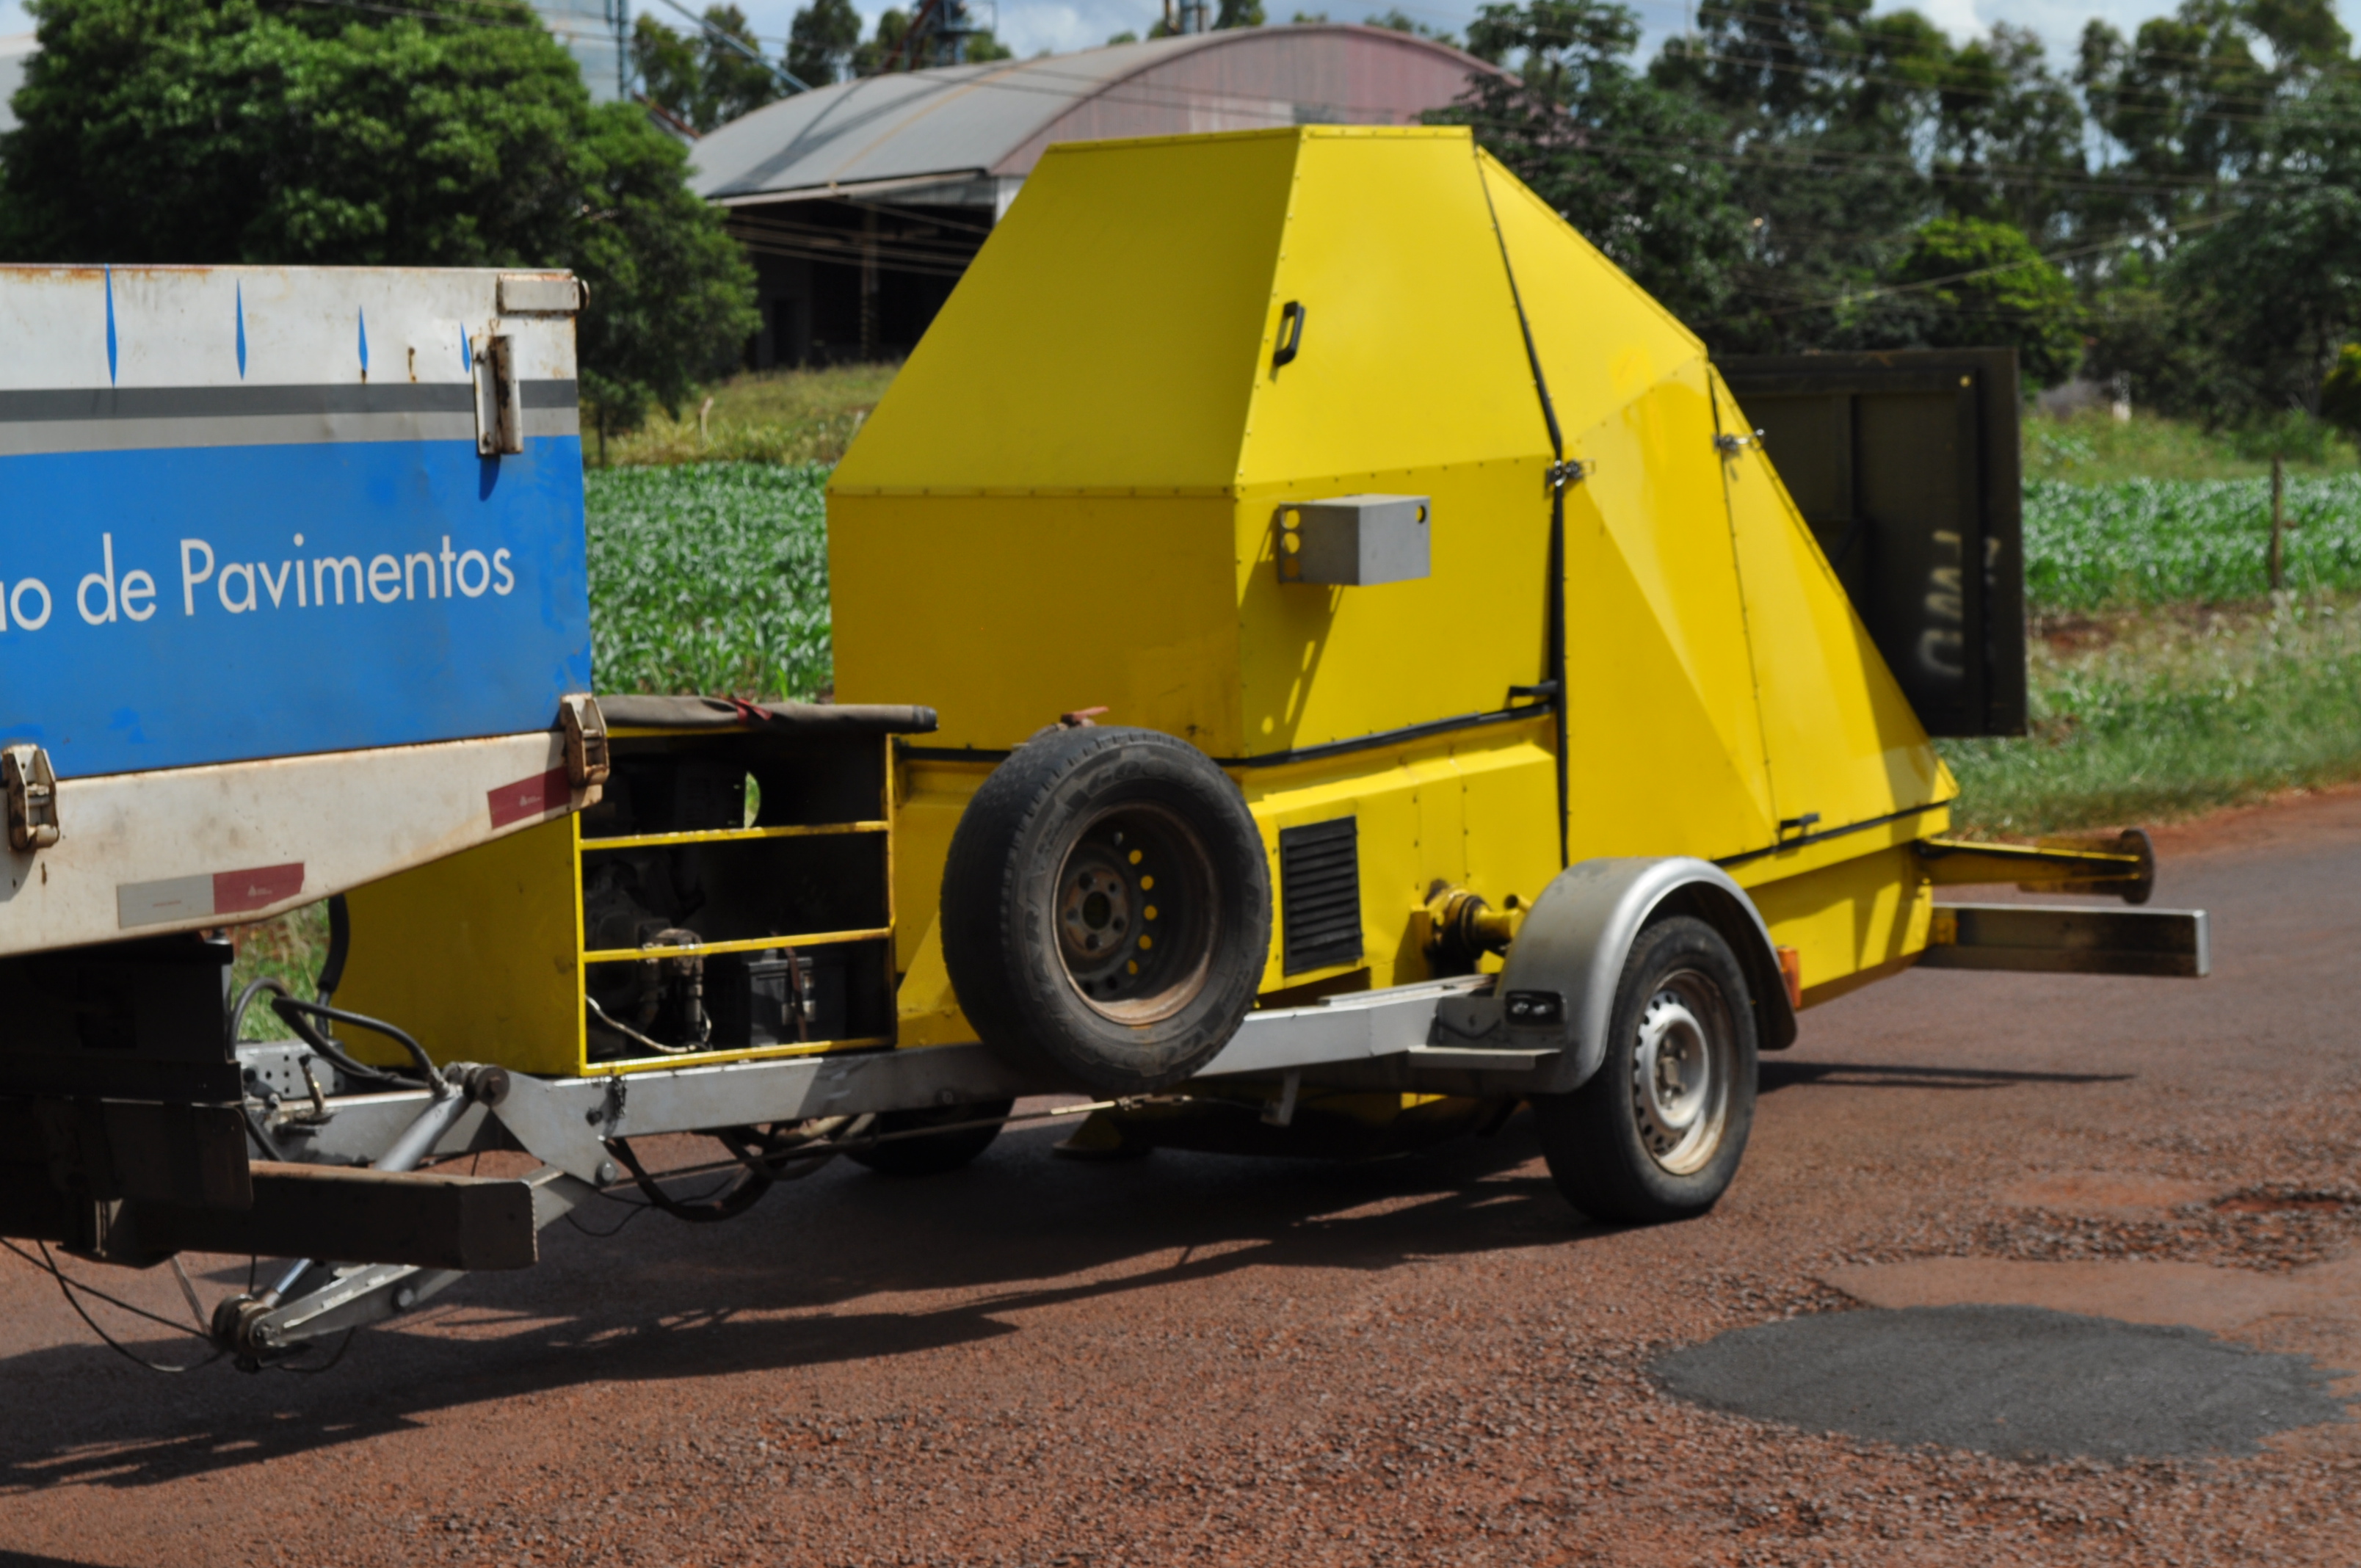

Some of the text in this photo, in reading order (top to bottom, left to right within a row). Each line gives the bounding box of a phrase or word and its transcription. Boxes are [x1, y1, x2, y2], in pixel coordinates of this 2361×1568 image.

[0, 533, 515, 632] o de Pavimentos
